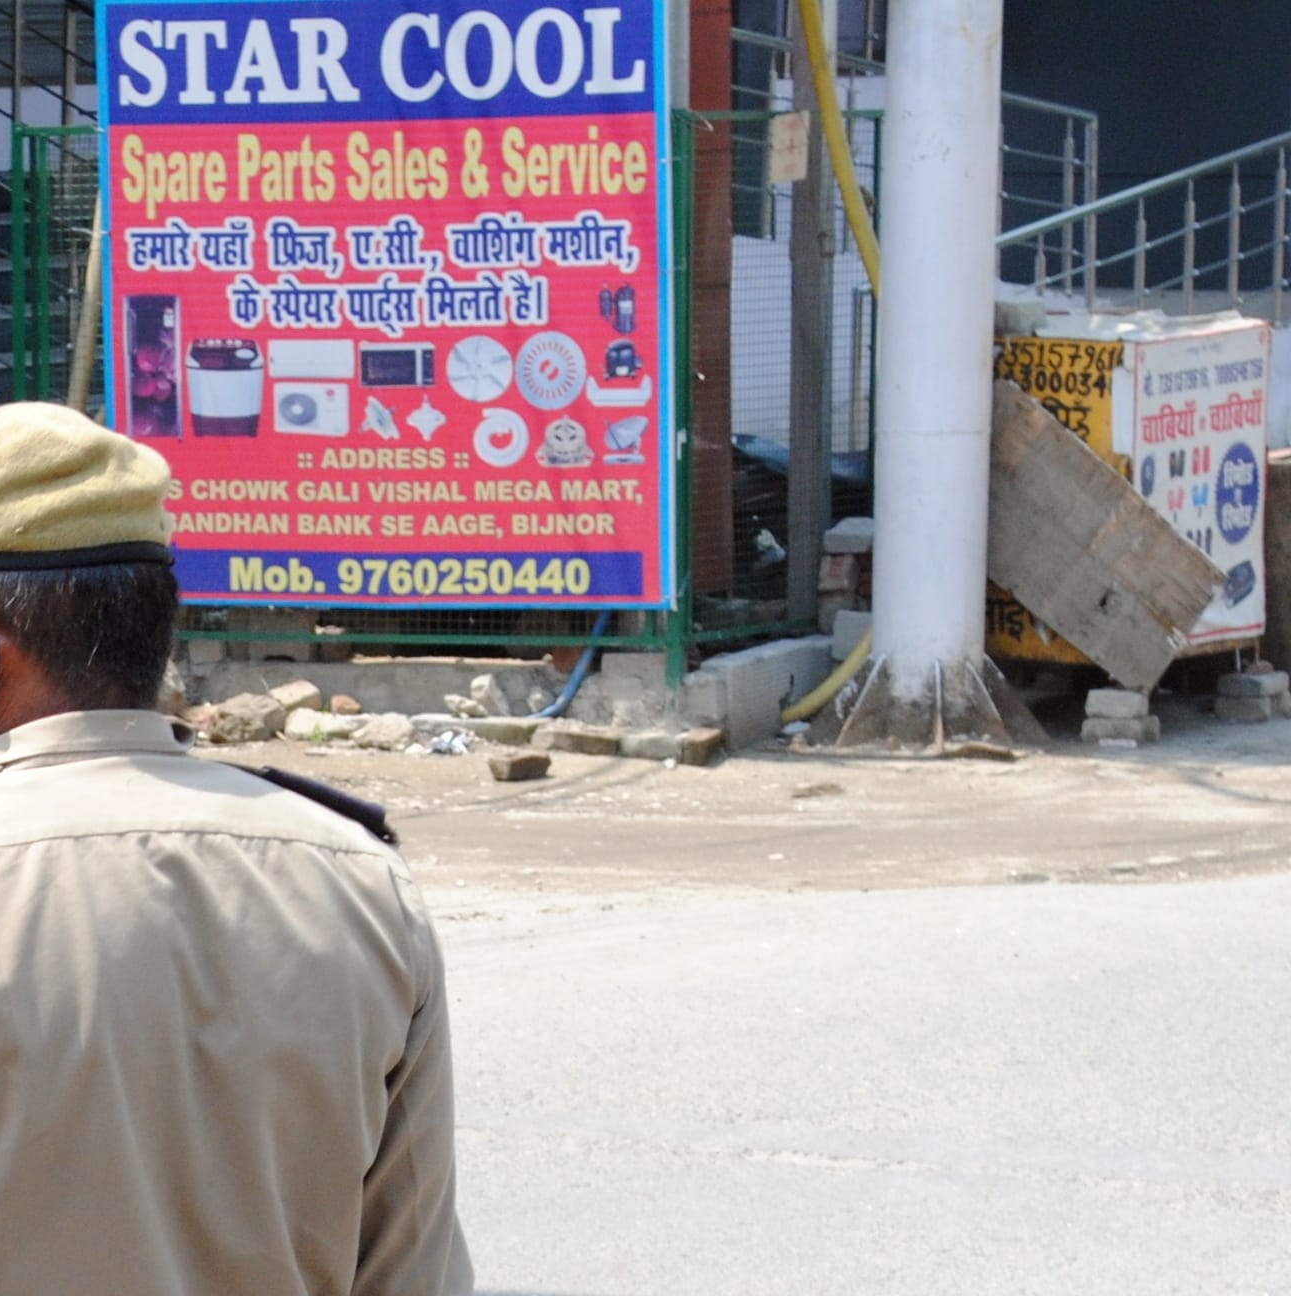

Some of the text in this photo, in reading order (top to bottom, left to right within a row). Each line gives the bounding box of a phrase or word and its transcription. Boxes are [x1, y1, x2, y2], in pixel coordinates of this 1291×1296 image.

[119, 7, 646, 107] STAR COOL
[122, 125, 647, 219] Spare Parts Sales & Service
[130, 221, 191, 266] हमारे
[269, 221, 339, 274] फ्रिज,
[450, 216, 536, 263] वाशिंग
[545, 215, 634, 268] मशीन,
[232, 278, 260, 323] के
[269, 278, 338, 323] स्पेयर
[346, 277, 416, 334] पार्ट्स
[425, 276, 502, 322] मिलते
[321, 448, 446, 469] ADDRESS
[168, 479, 644, 505] S CHOWK GALI VISHAL MEGA MART,
[297, 513, 373, 535] BANK
[380, 514, 415, 536] SE
[422, 514, 503, 539] AAGE,
[512, 513, 615, 535] BIJNOR
[229, 556, 591, 595] Mob. 9760250440
